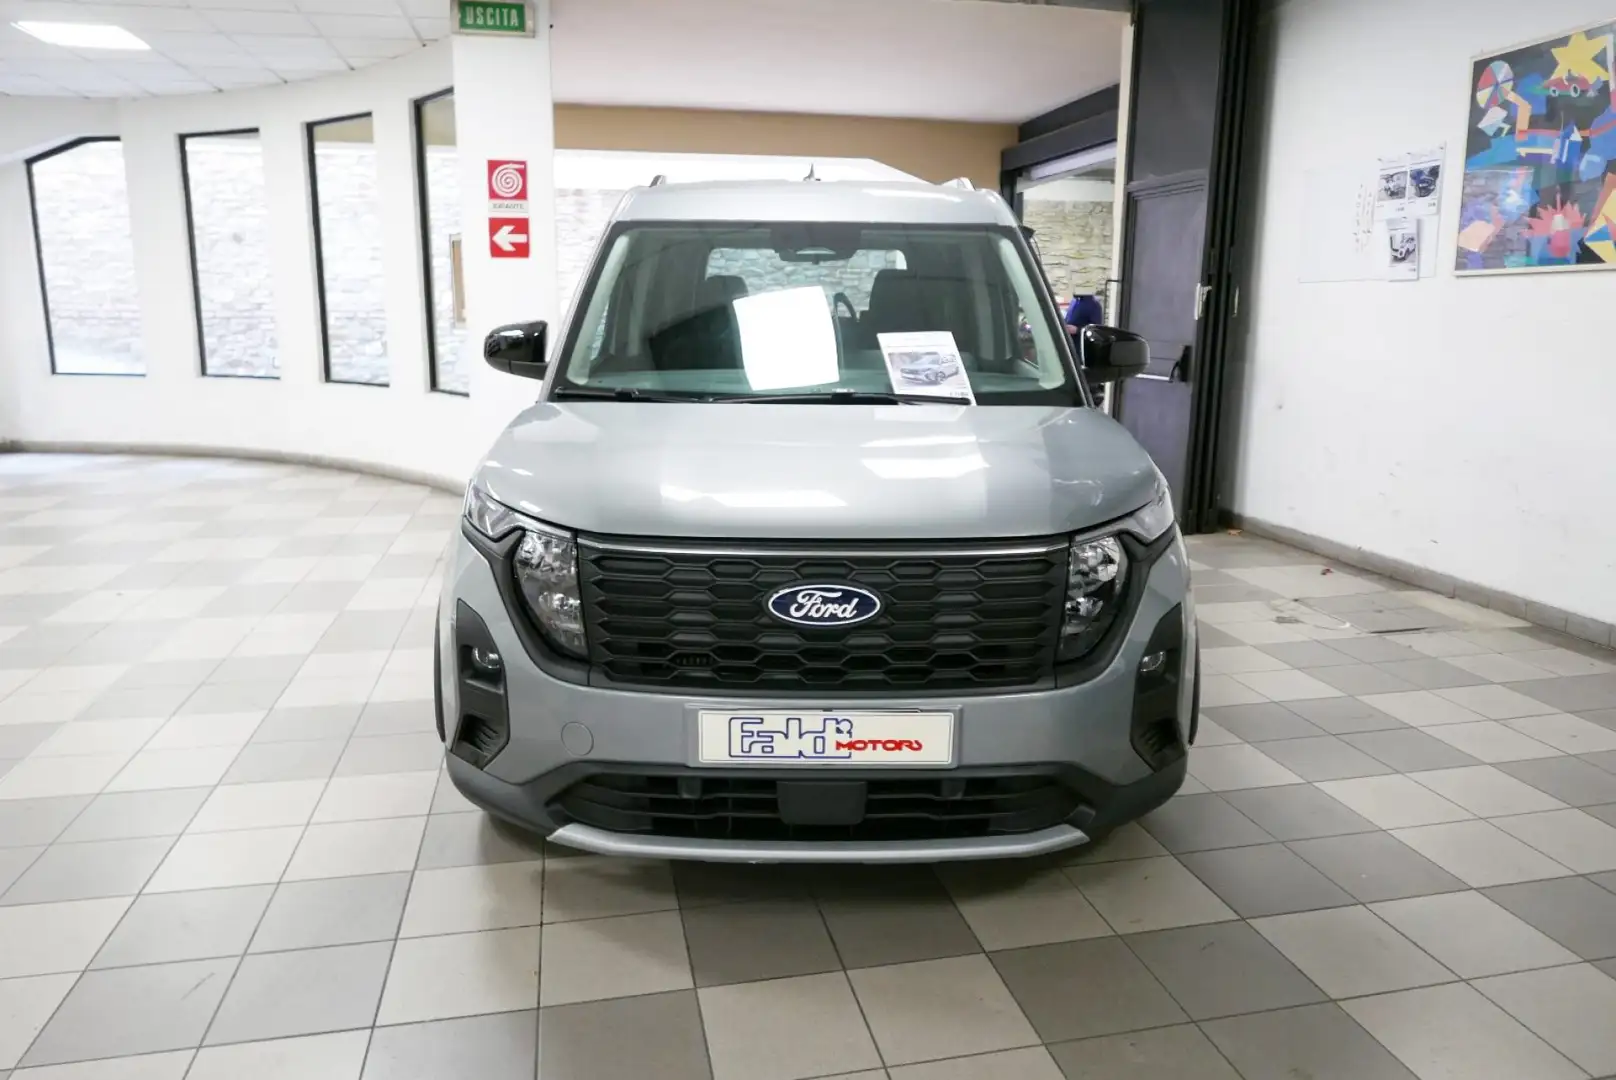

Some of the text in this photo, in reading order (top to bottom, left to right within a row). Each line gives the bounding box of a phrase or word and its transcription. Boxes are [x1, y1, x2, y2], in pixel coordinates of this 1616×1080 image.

[465, 6, 519, 27] USCITA
[790, 590, 859, 618] Ford
[835, 739, 923, 752] MOTORS
